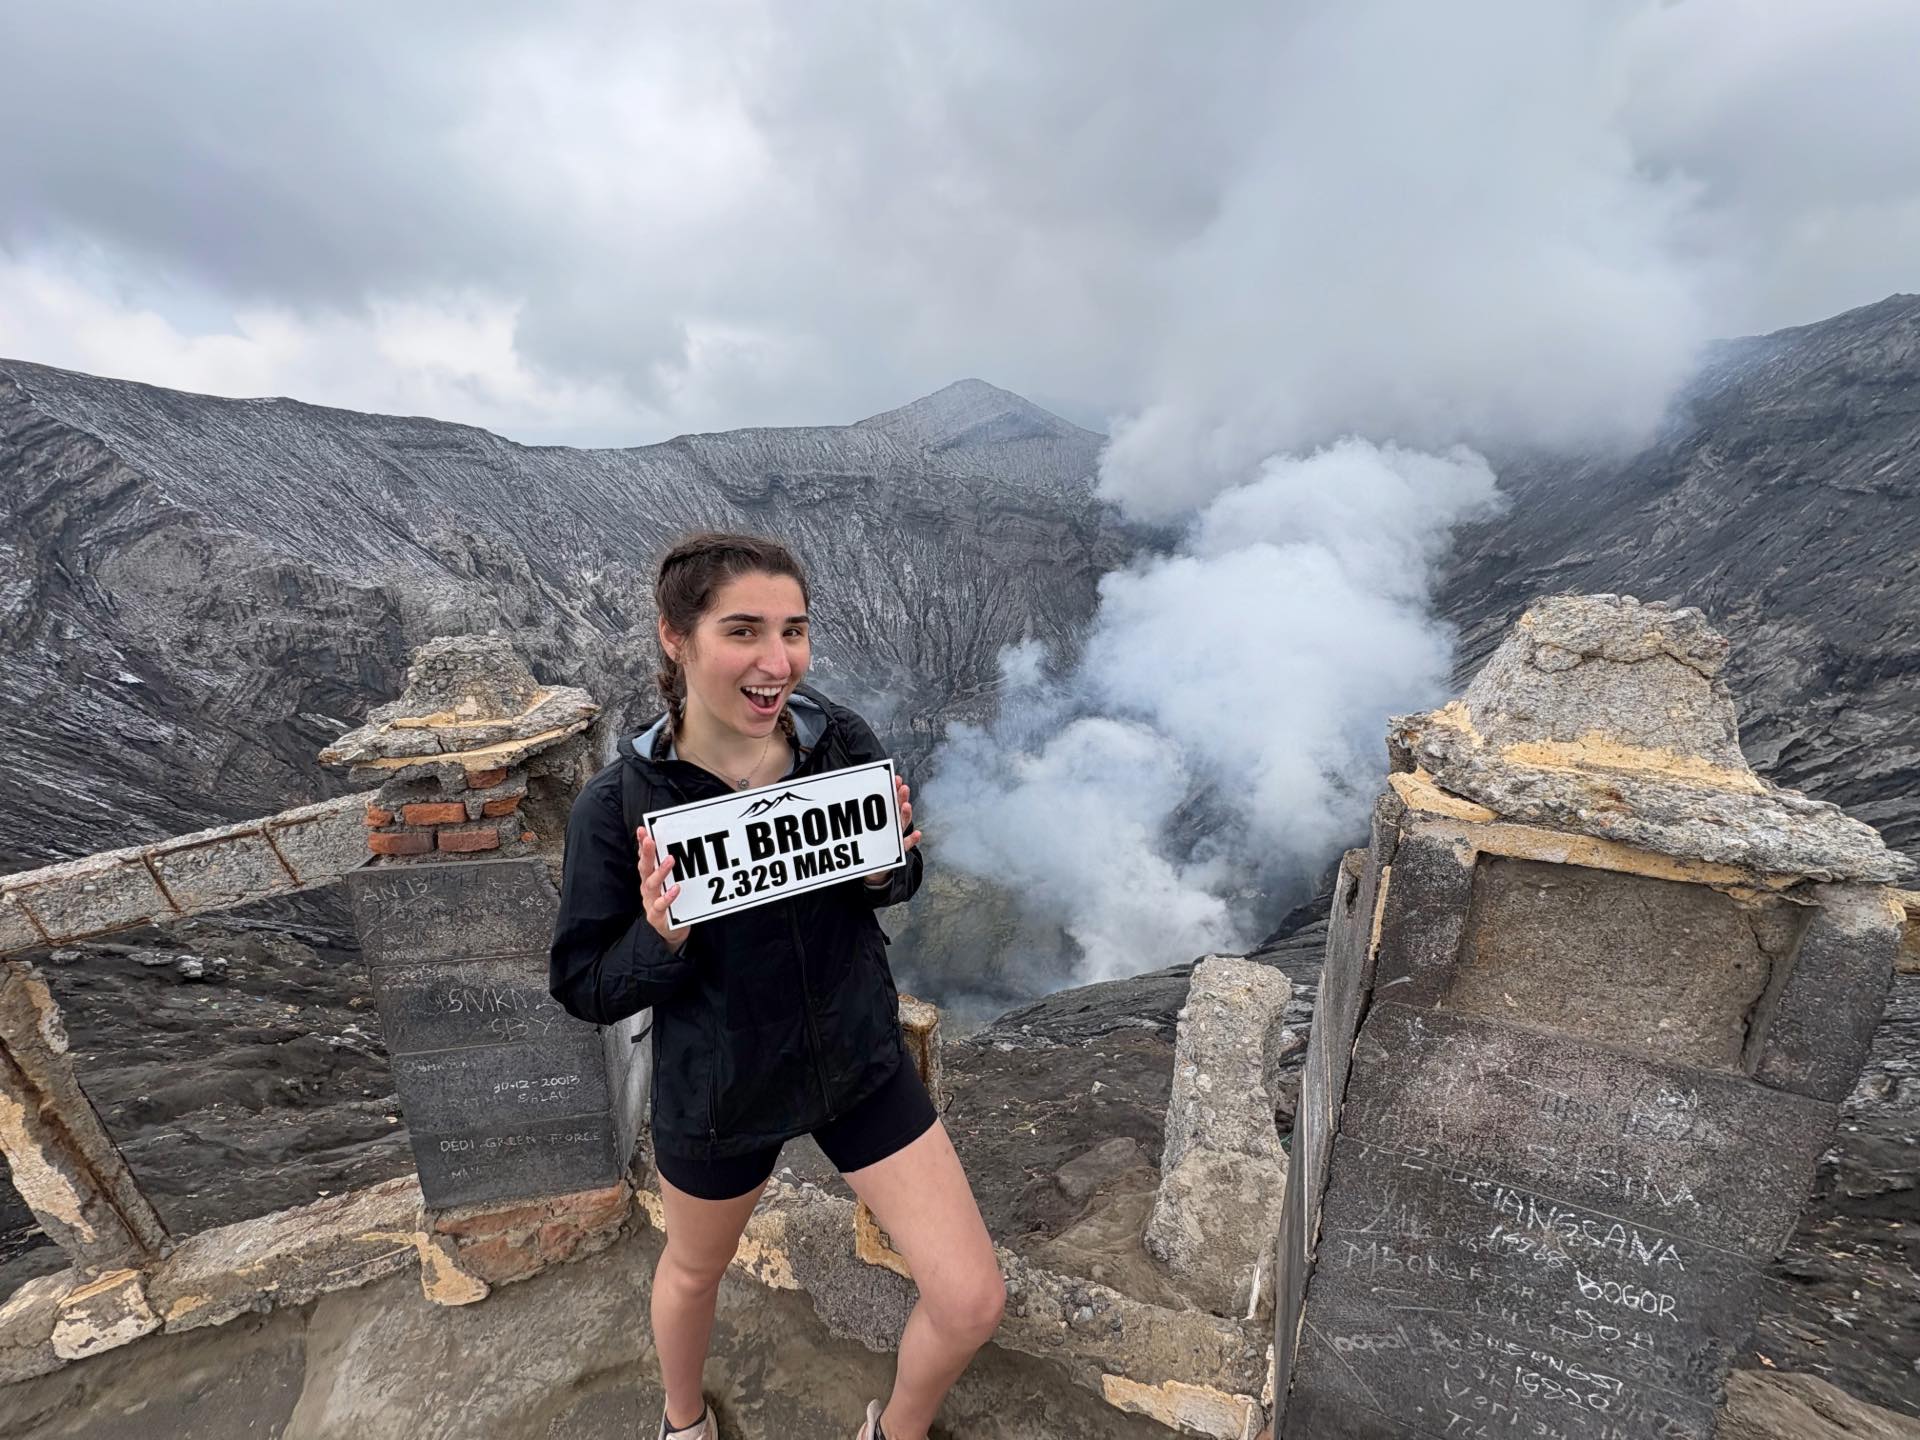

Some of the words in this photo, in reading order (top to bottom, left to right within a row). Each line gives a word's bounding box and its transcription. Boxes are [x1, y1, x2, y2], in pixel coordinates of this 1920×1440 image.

[667, 830, 741, 882] MT.
[745, 793, 888, 861] BROMO
[708, 860, 788, 905] 2.329
[793, 841, 865, 880] MASL
[1576, 1270, 1679, 1322] BOGOR
